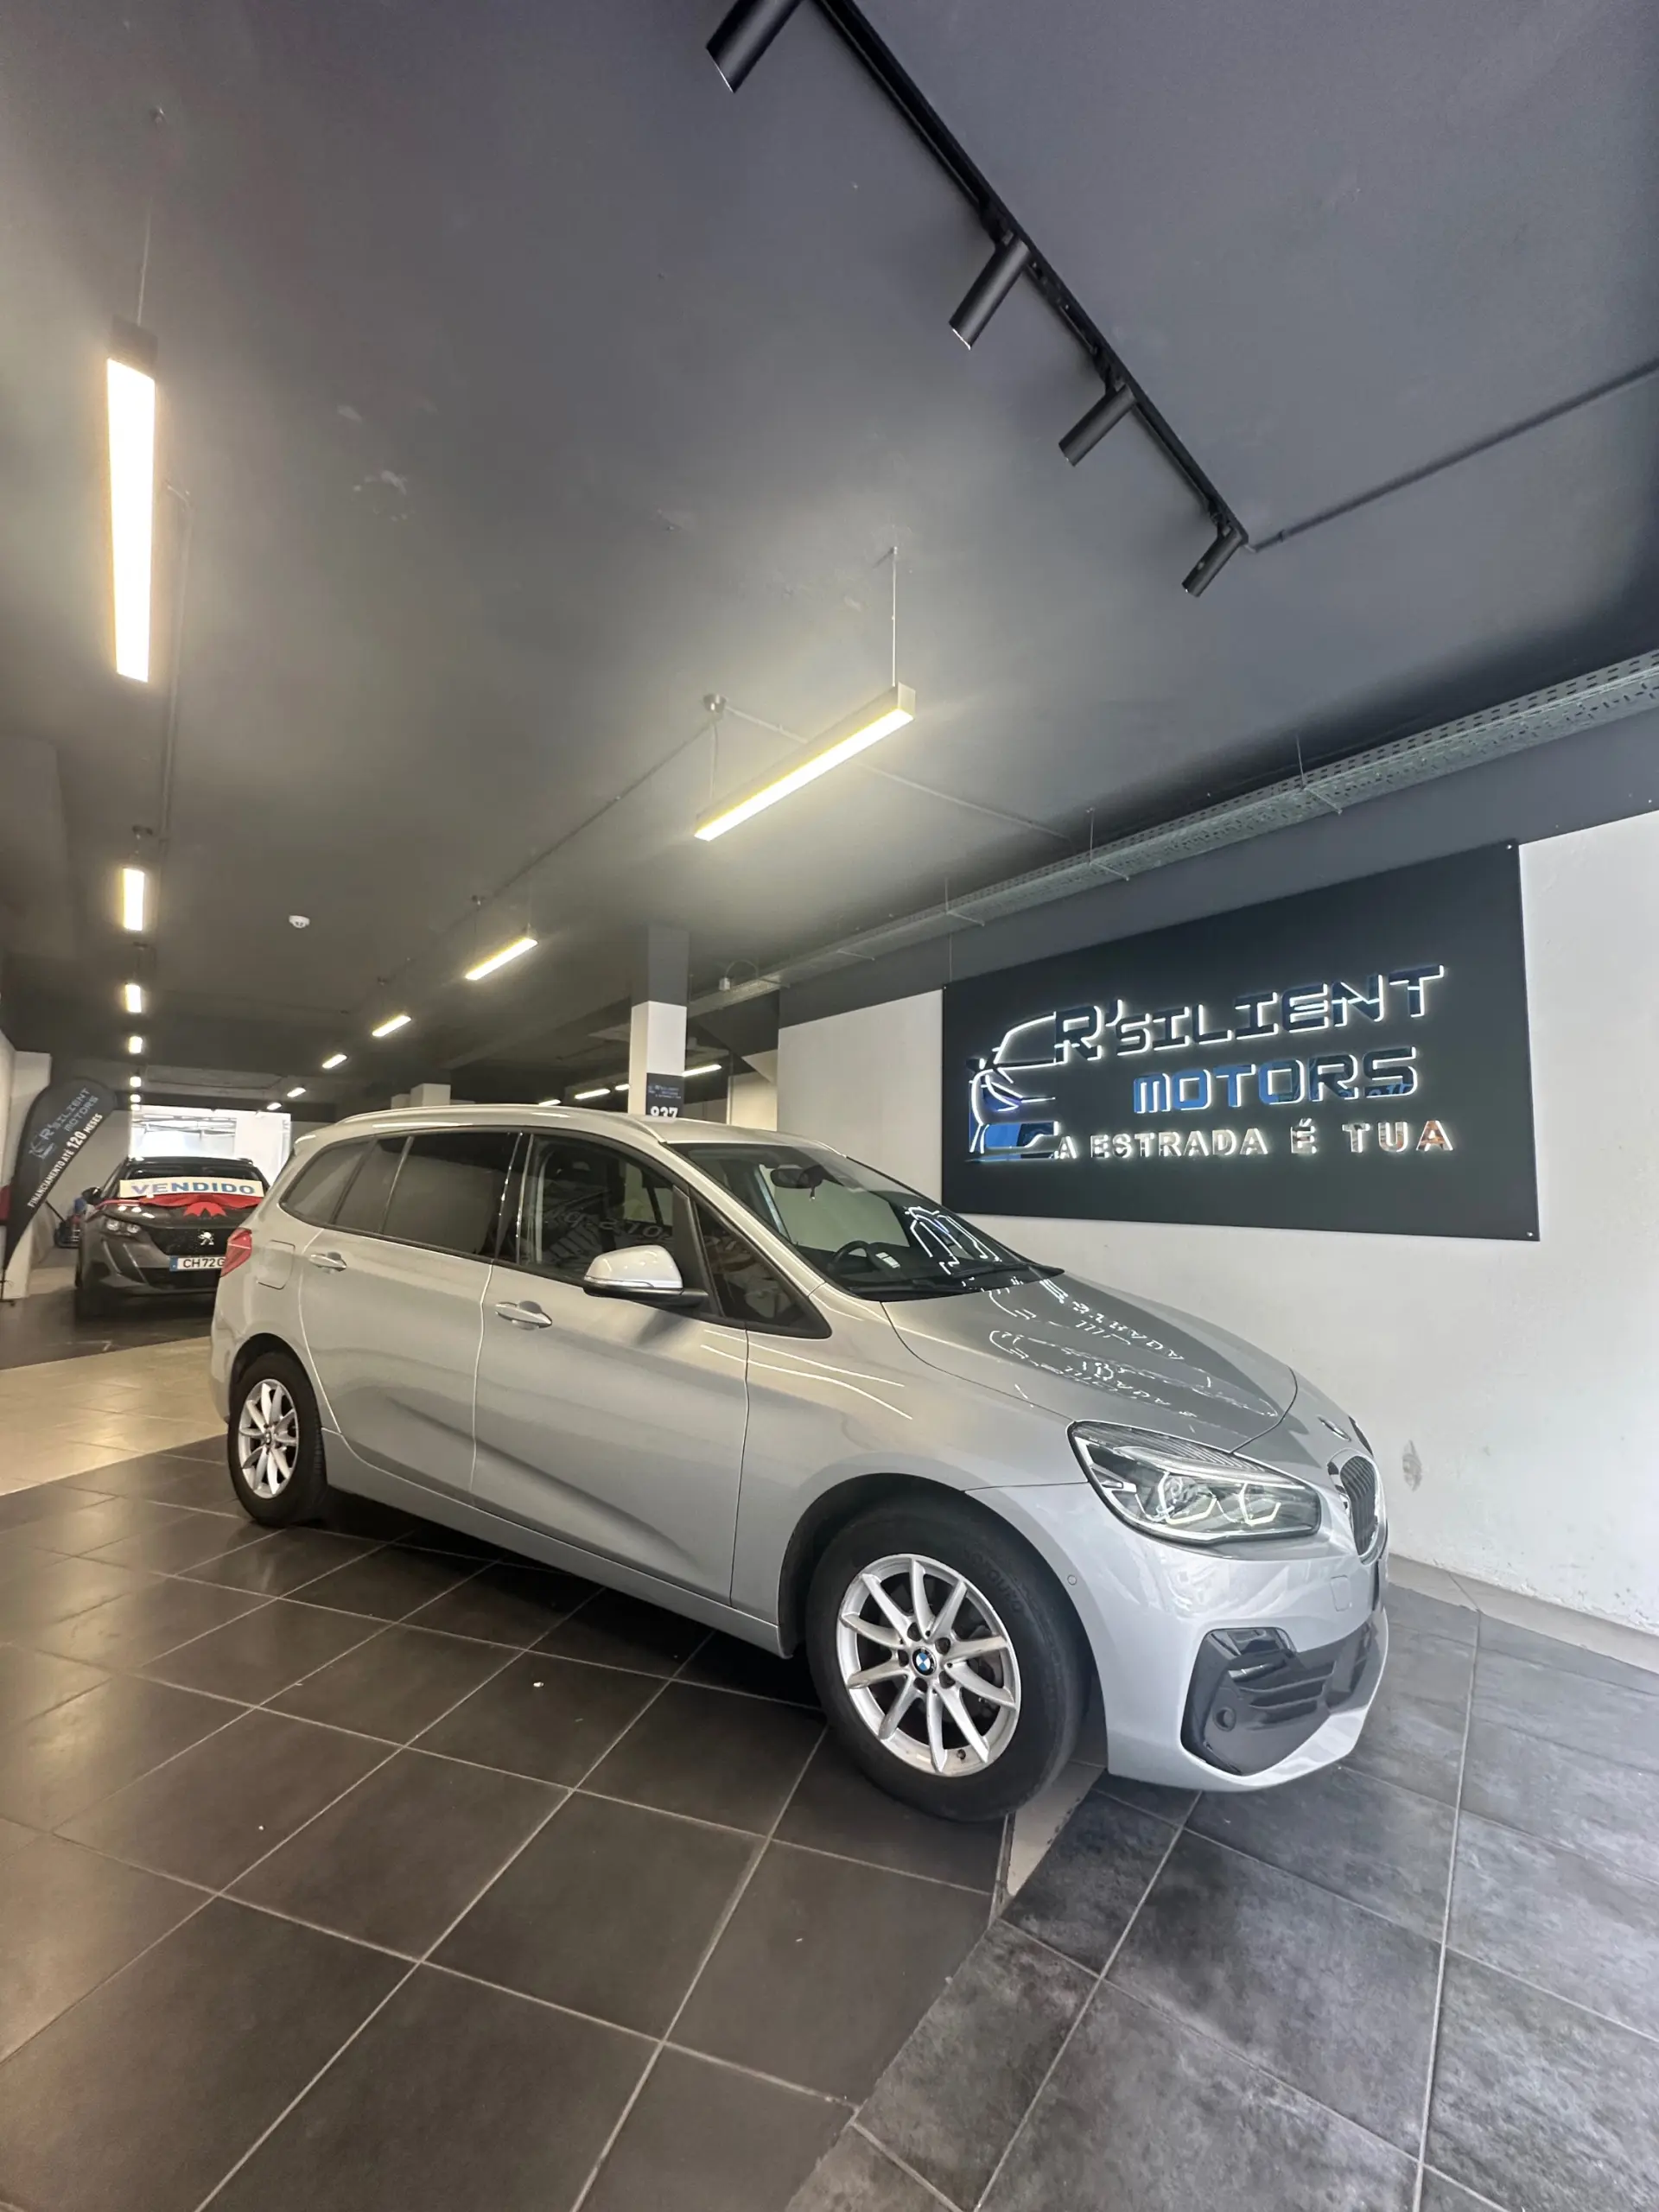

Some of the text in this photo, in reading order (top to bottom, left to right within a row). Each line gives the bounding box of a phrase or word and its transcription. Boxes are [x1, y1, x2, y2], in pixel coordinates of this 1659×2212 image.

[1054, 964, 1445, 1064] R'SILIENT
[1133, 1046, 1418, 1114] MOTORS
[64, 1095, 99, 1132] MOTORS
[1055, 1118, 1454, 1160] A ESTRADA É TUA
[27, 1113, 103, 1208] FINANCIAMENTO ATÉ 120 MESES
[131, 1182, 256, 1195] VENDIDO
